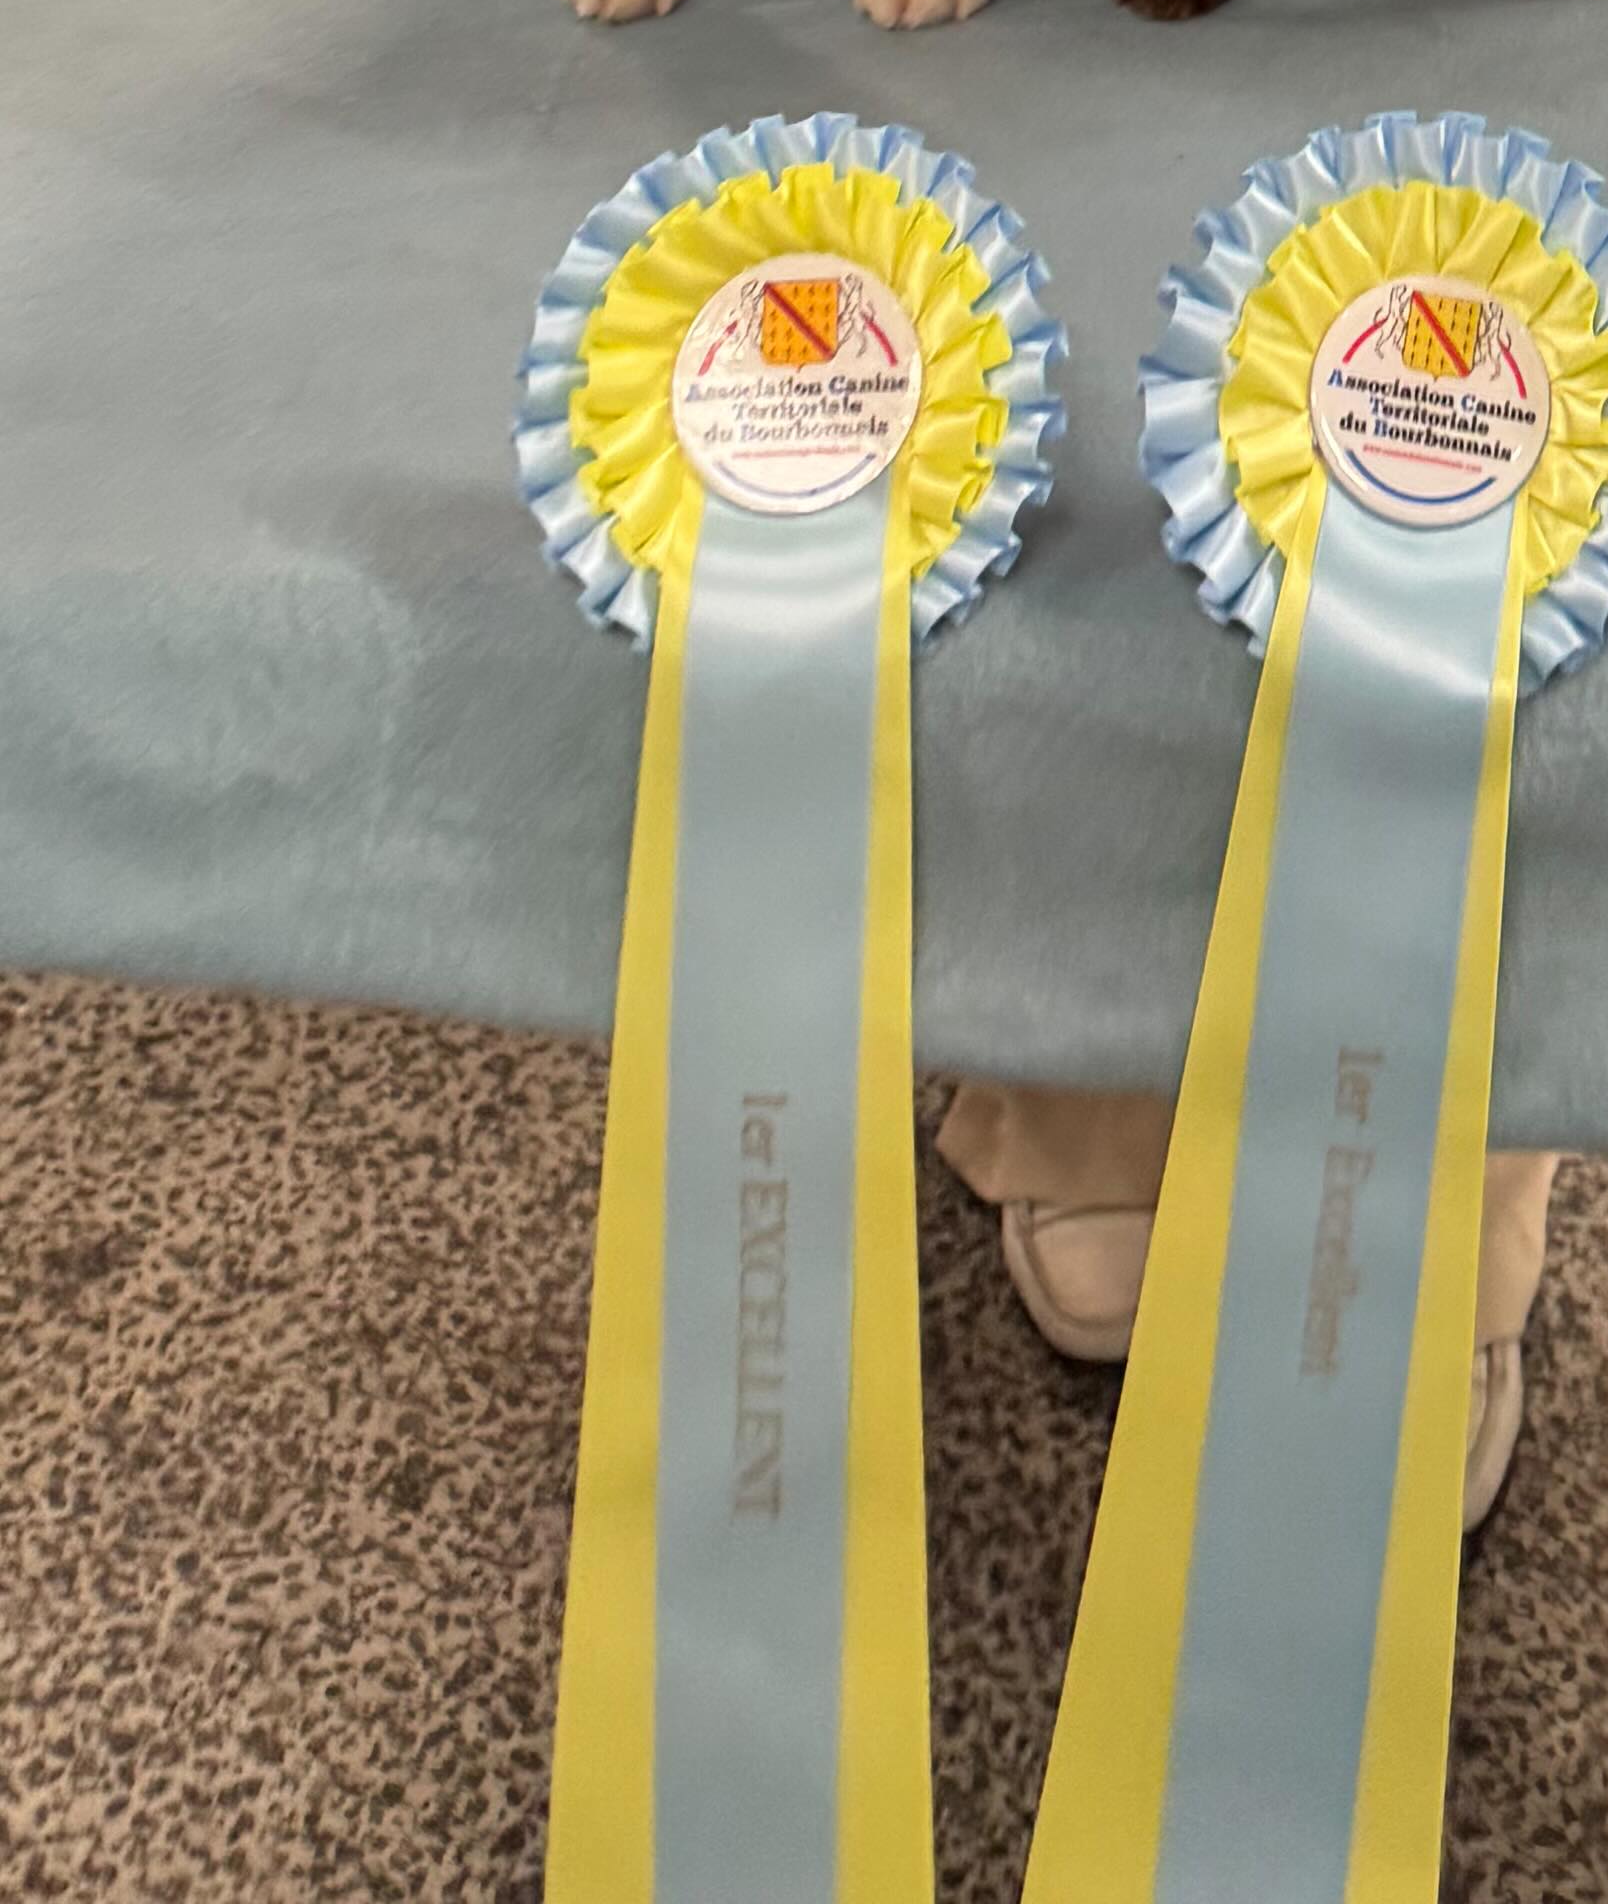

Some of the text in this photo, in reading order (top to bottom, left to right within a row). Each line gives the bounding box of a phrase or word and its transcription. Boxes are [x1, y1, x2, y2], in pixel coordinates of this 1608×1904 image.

[1327, 368, 1537, 425] Association Canine
[1369, 395, 1489, 436] Territoriale
[1339, 411, 1367, 433] du
[1373, 419, 1513, 462] Bourbonnais
